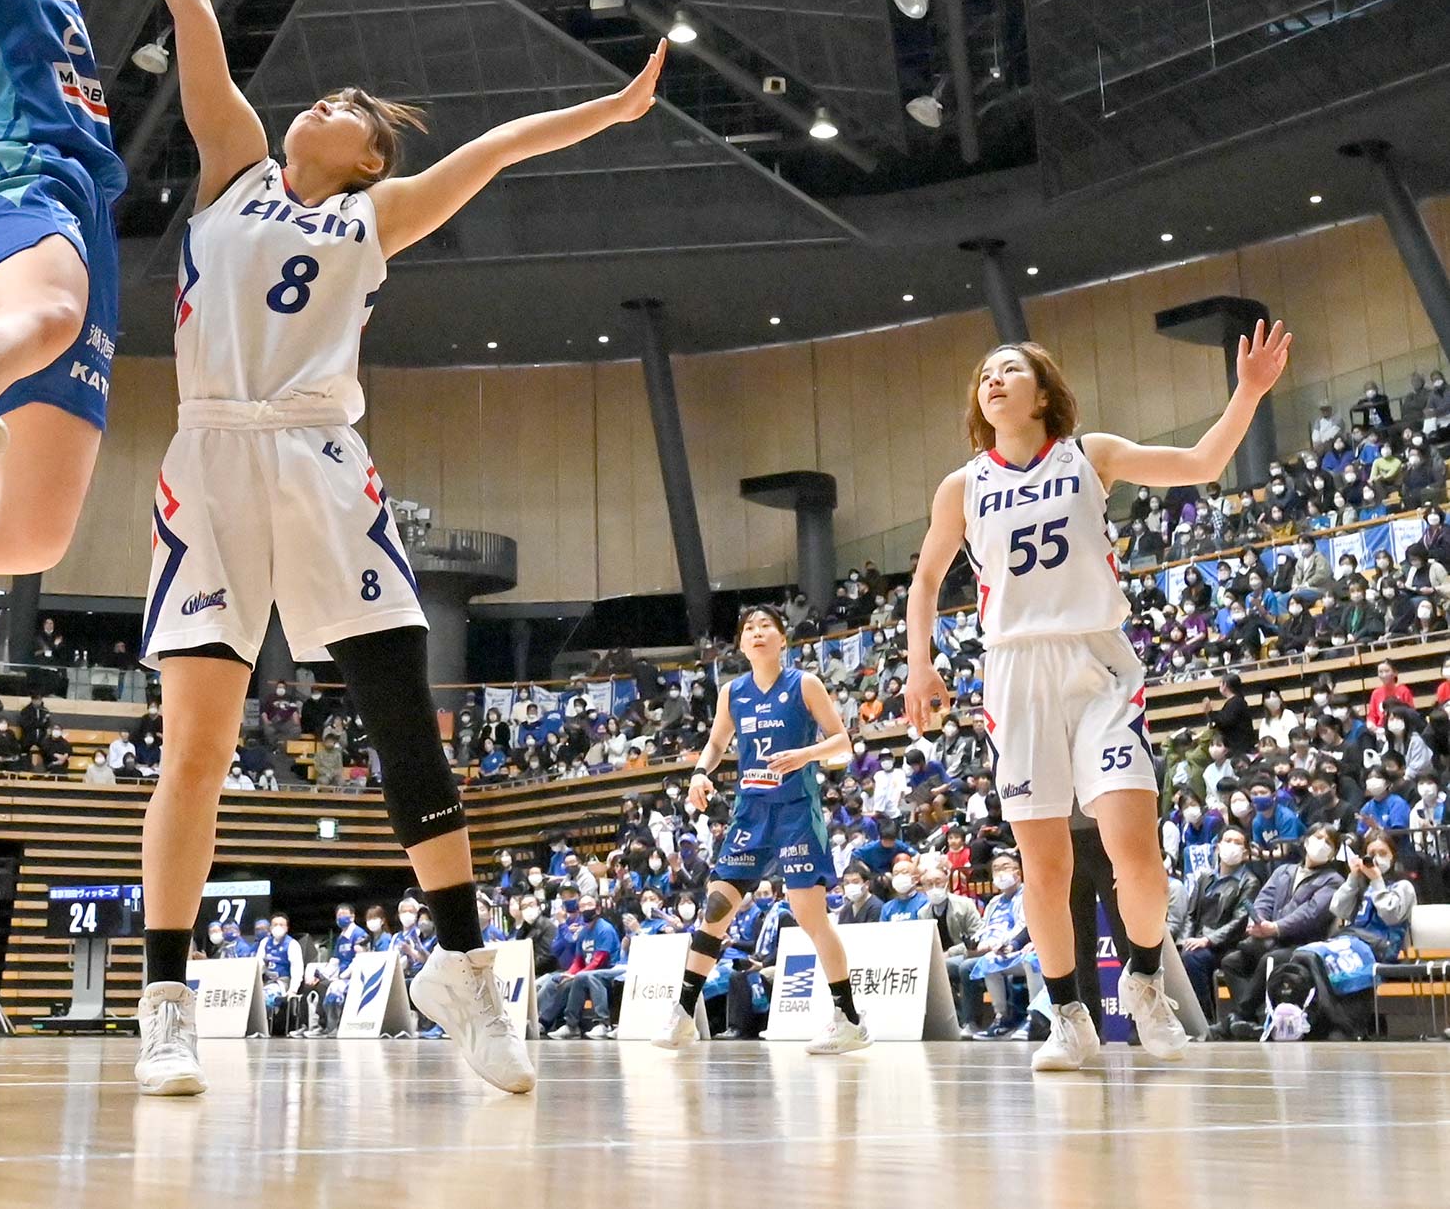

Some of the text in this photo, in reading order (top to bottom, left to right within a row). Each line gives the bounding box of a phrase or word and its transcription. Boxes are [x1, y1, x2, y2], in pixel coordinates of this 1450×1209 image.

[239, 199, 366, 243] AISIN
[266, 255, 319, 314] 8
[980, 476, 1079, 518] AISIN
[1010, 517, 1069, 576] 55
[361, 569, 381, 601] 8
[758, 720, 785, 729] EBARA
[753, 737, 772, 761] 12
[1101, 745, 1132, 772] 55
[733, 828, 752, 847] 12
[69, 902, 97, 933] 24
[217, 898, 247, 925] 27
[848, 967, 918, 996] 原製作所
[779, 1000, 810, 1012] EBARA
